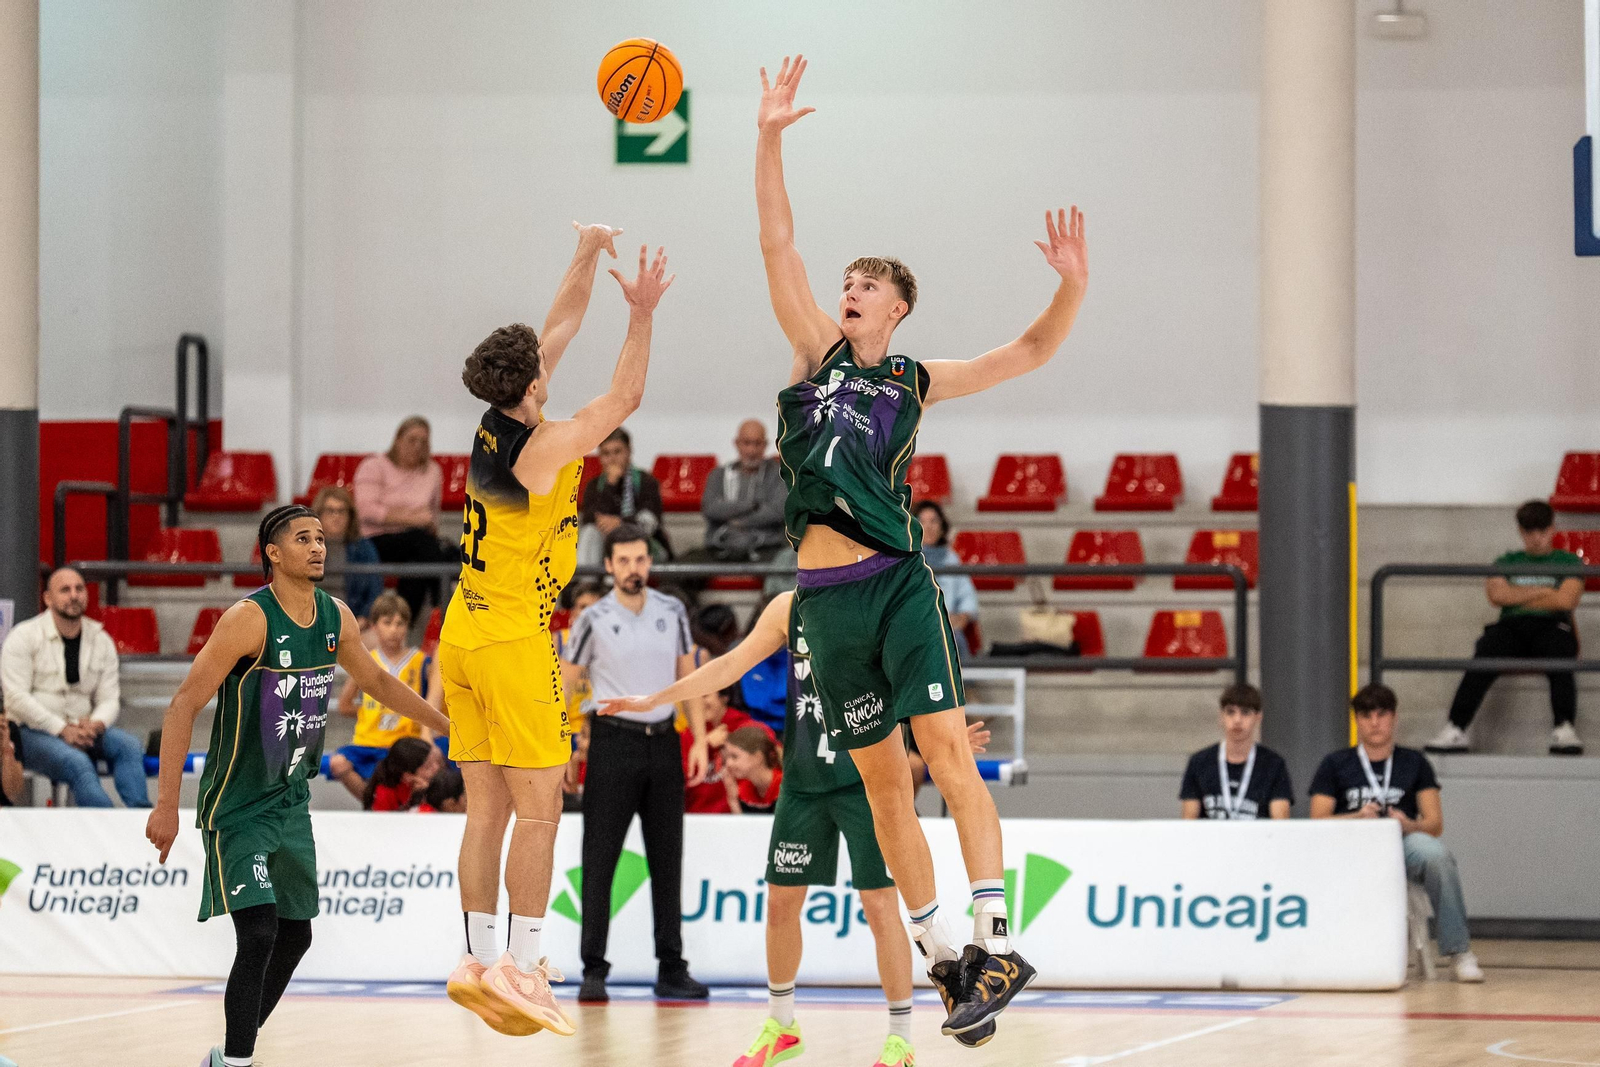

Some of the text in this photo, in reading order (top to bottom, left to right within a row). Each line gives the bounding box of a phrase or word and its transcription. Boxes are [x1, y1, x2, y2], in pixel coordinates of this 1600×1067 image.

[607, 73, 637, 116] Wilson
[854, 418, 874, 436] Torre
[824, 435, 842, 468] 1
[300, 670, 334, 688] Fundació
[300, 684, 328, 700] Unicaja
[844, 691, 875, 709] CLINICAS
[852, 718, 883, 736] DENTAL
[816, 733, 836, 764] 4
[778, 841, 808, 850] CLINICAS
[33, 862, 189, 888] Fundación
[317, 863, 455, 889] undación
[775, 866, 804, 874] DENTAL
[28, 889, 140, 921] Unicaja
[318, 891, 405, 923] nicaja
[681, 879, 869, 938] Uniaj
[1087, 883, 1309, 943] Unicaja
